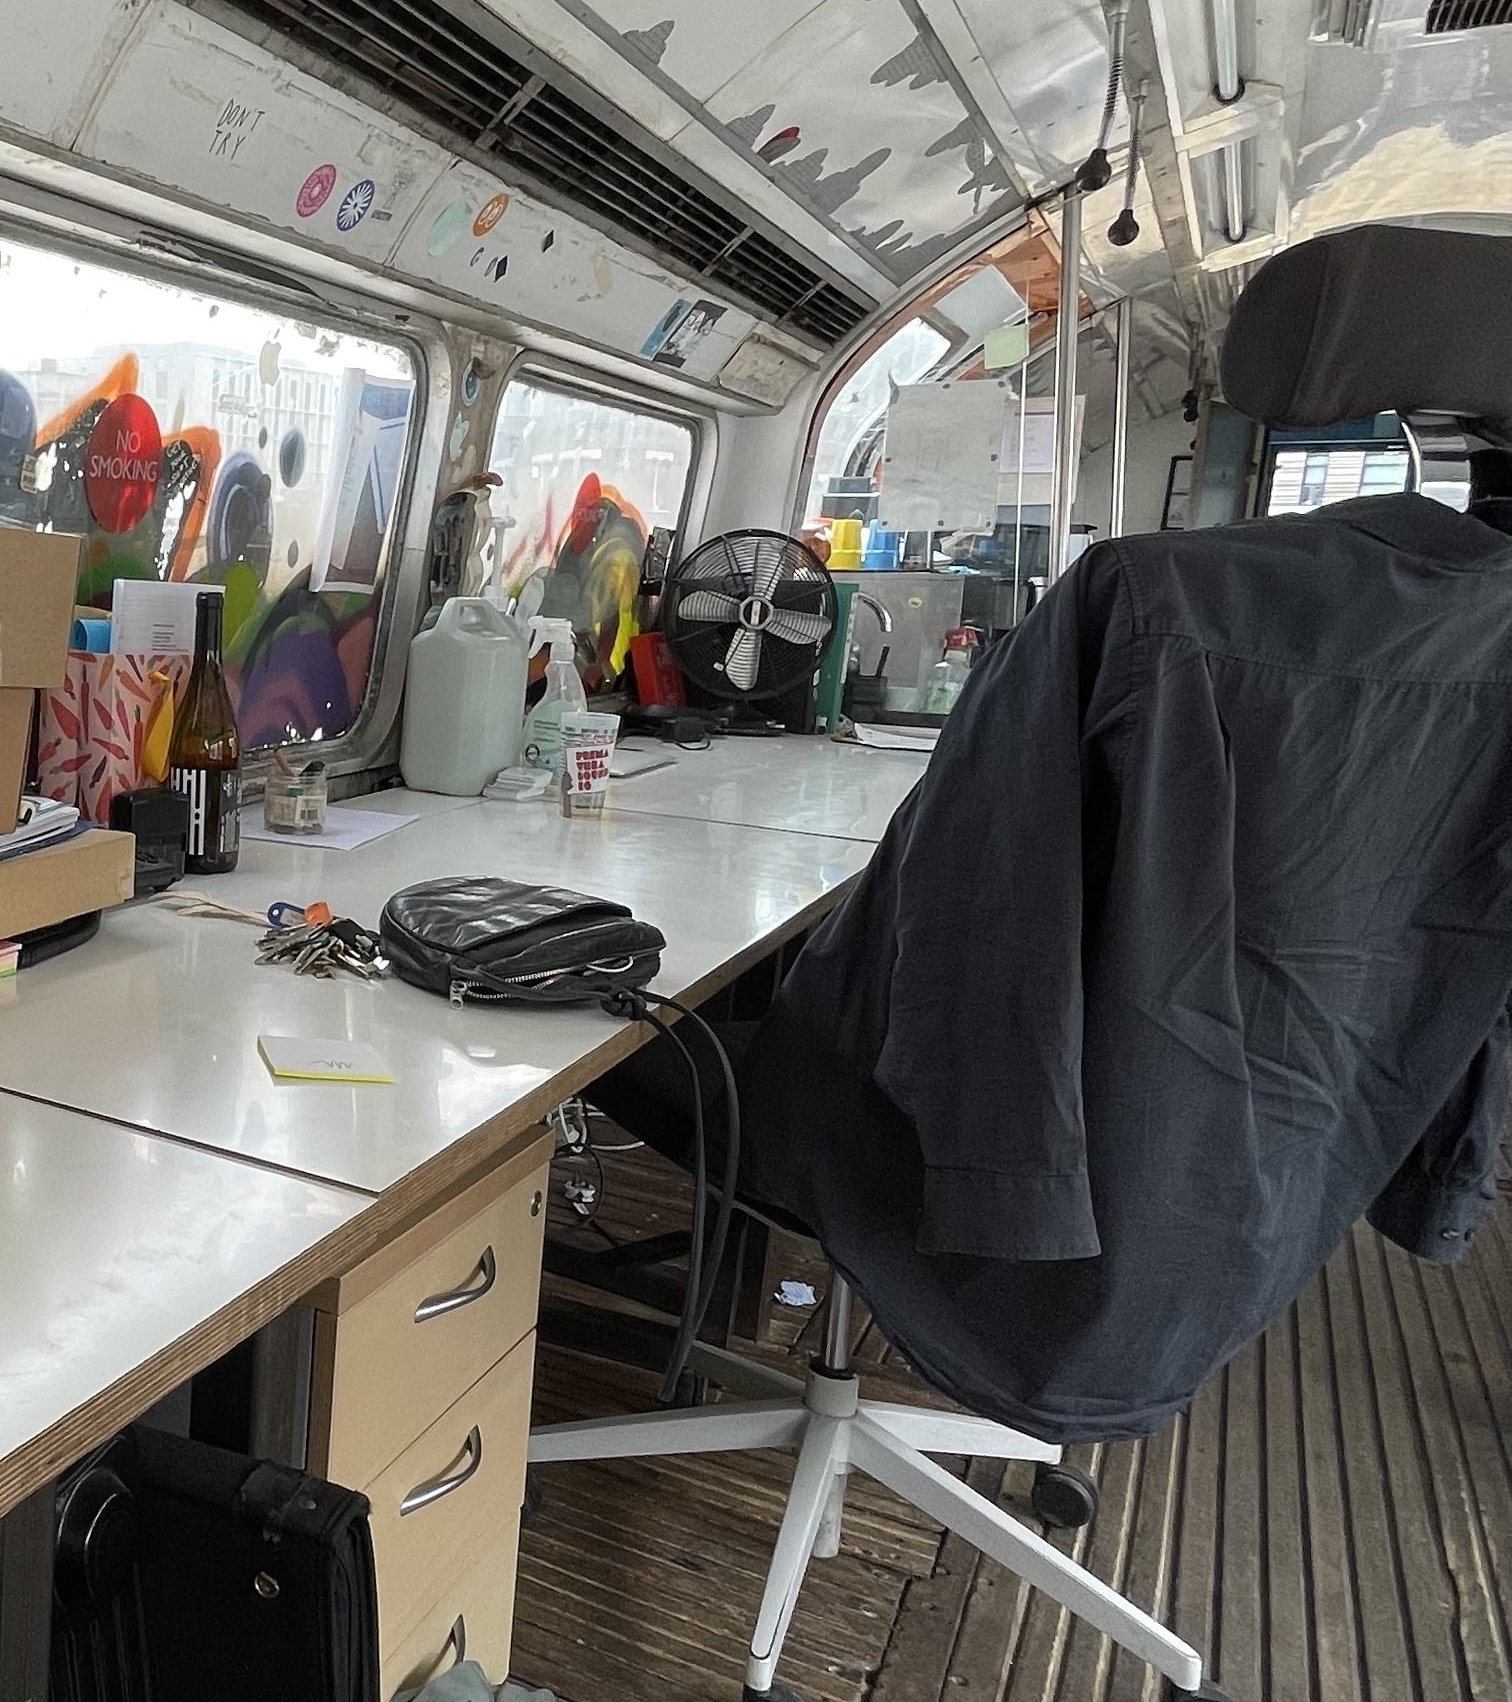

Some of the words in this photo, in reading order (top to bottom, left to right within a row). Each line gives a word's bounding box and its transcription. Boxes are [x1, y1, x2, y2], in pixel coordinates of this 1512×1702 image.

[216, 98, 265, 131] DON'T
[209, 129, 246, 160] TRY
[116, 429, 141, 453] NO
[90, 455, 158, 482] SMOKING
